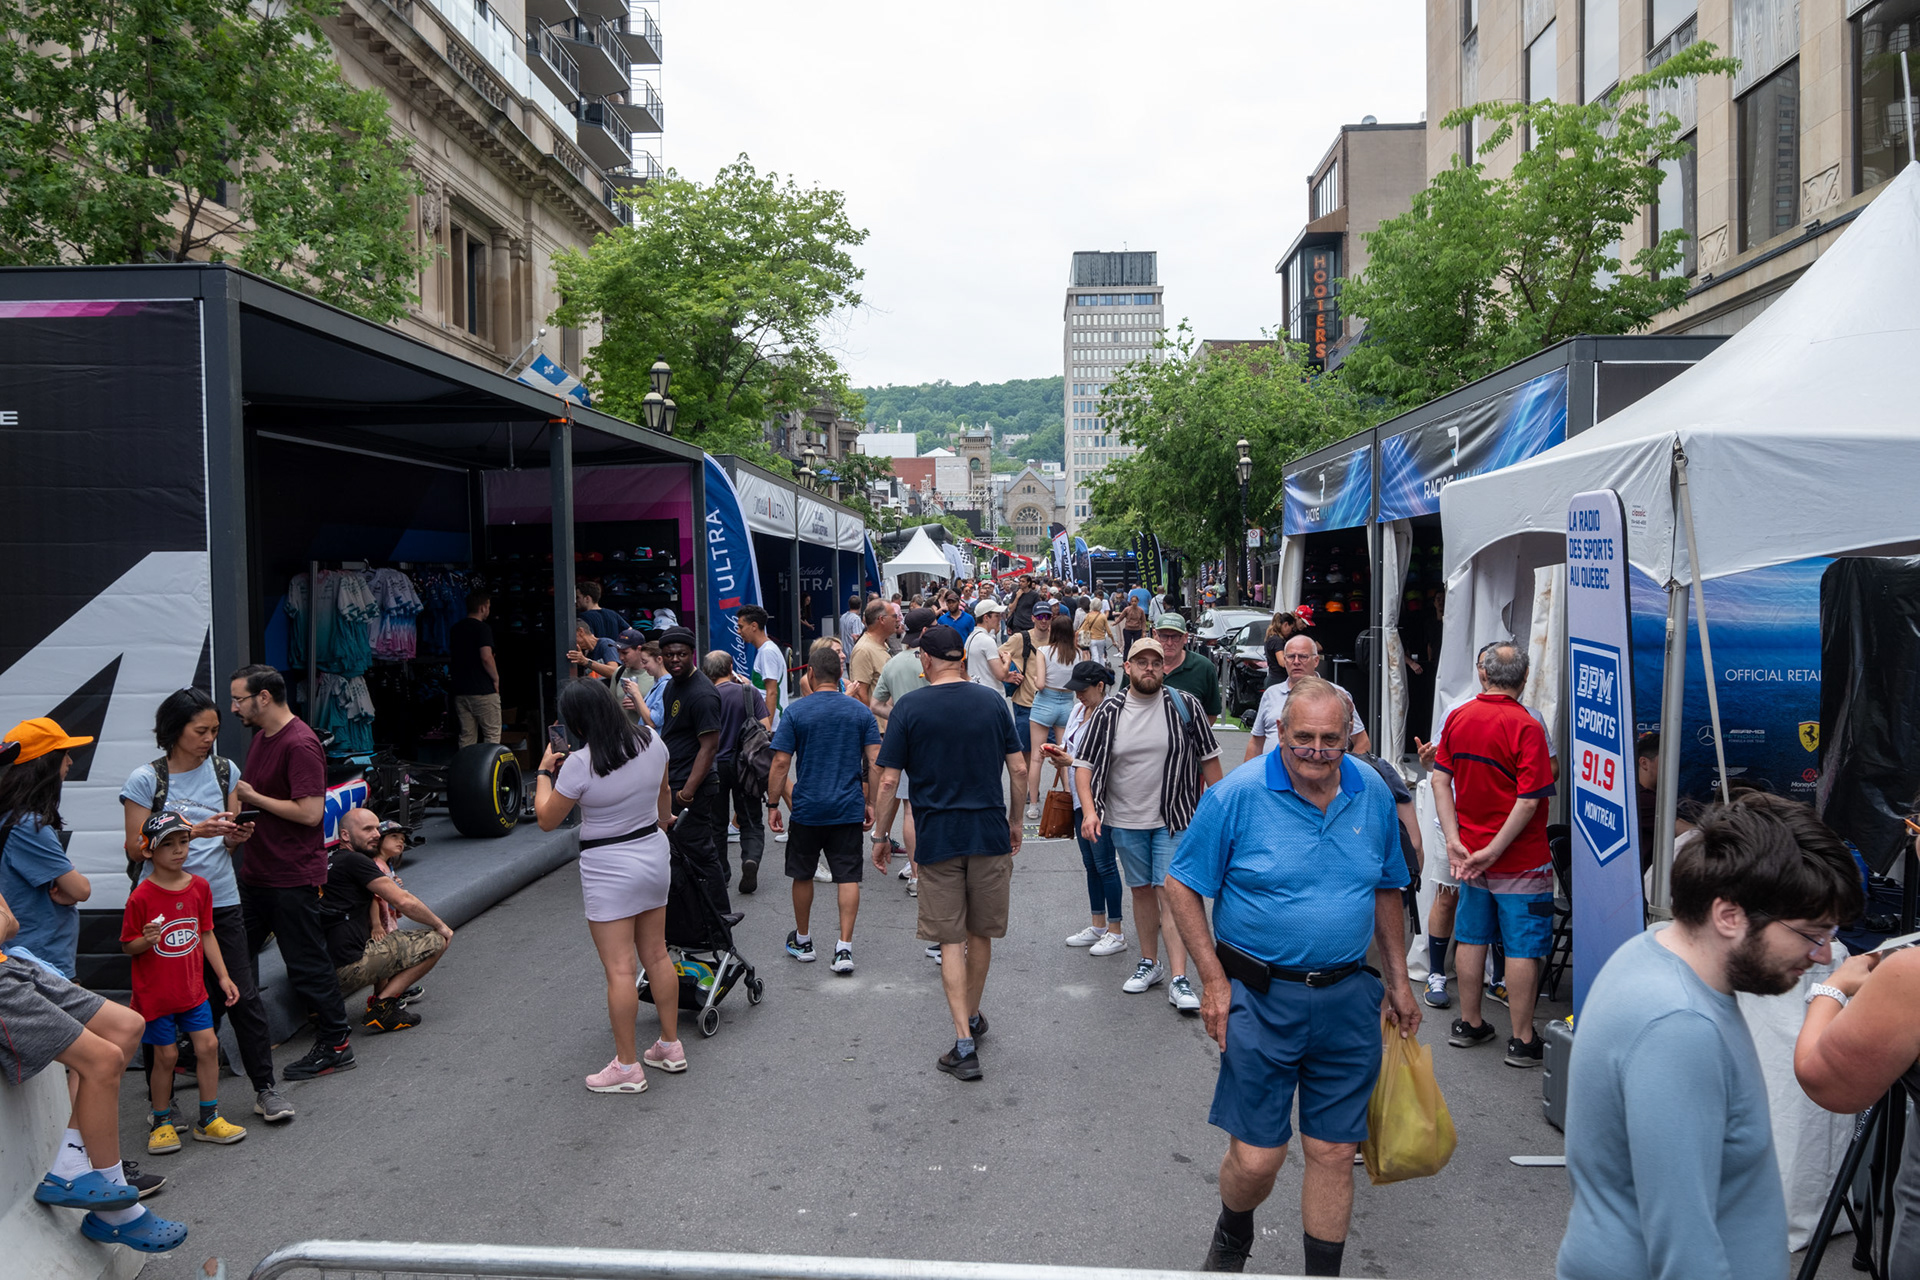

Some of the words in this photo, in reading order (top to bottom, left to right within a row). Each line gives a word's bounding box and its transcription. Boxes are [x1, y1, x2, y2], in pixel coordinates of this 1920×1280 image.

[1314, 255, 1327, 358] HOOTERS
[1569, 511, 1577, 531] LA
[1579, 510, 1600, 531] RADIO
[706, 508, 735, 592] ULTRA
[1569, 538, 1582, 559] DES
[1584, 538, 1613, 560] SPORTS
[1570, 565, 1579, 587] AU
[1581, 563, 1610, 590] QUÉBEC
[1577, 663, 1614, 705] BPM
[1725, 669, 1783, 682] OFFICIAL
[1578, 706, 1616, 739] SPORTS
[1582, 750, 1615, 791] 91.9
[1584, 800, 1616, 831] MONTRÉAL
